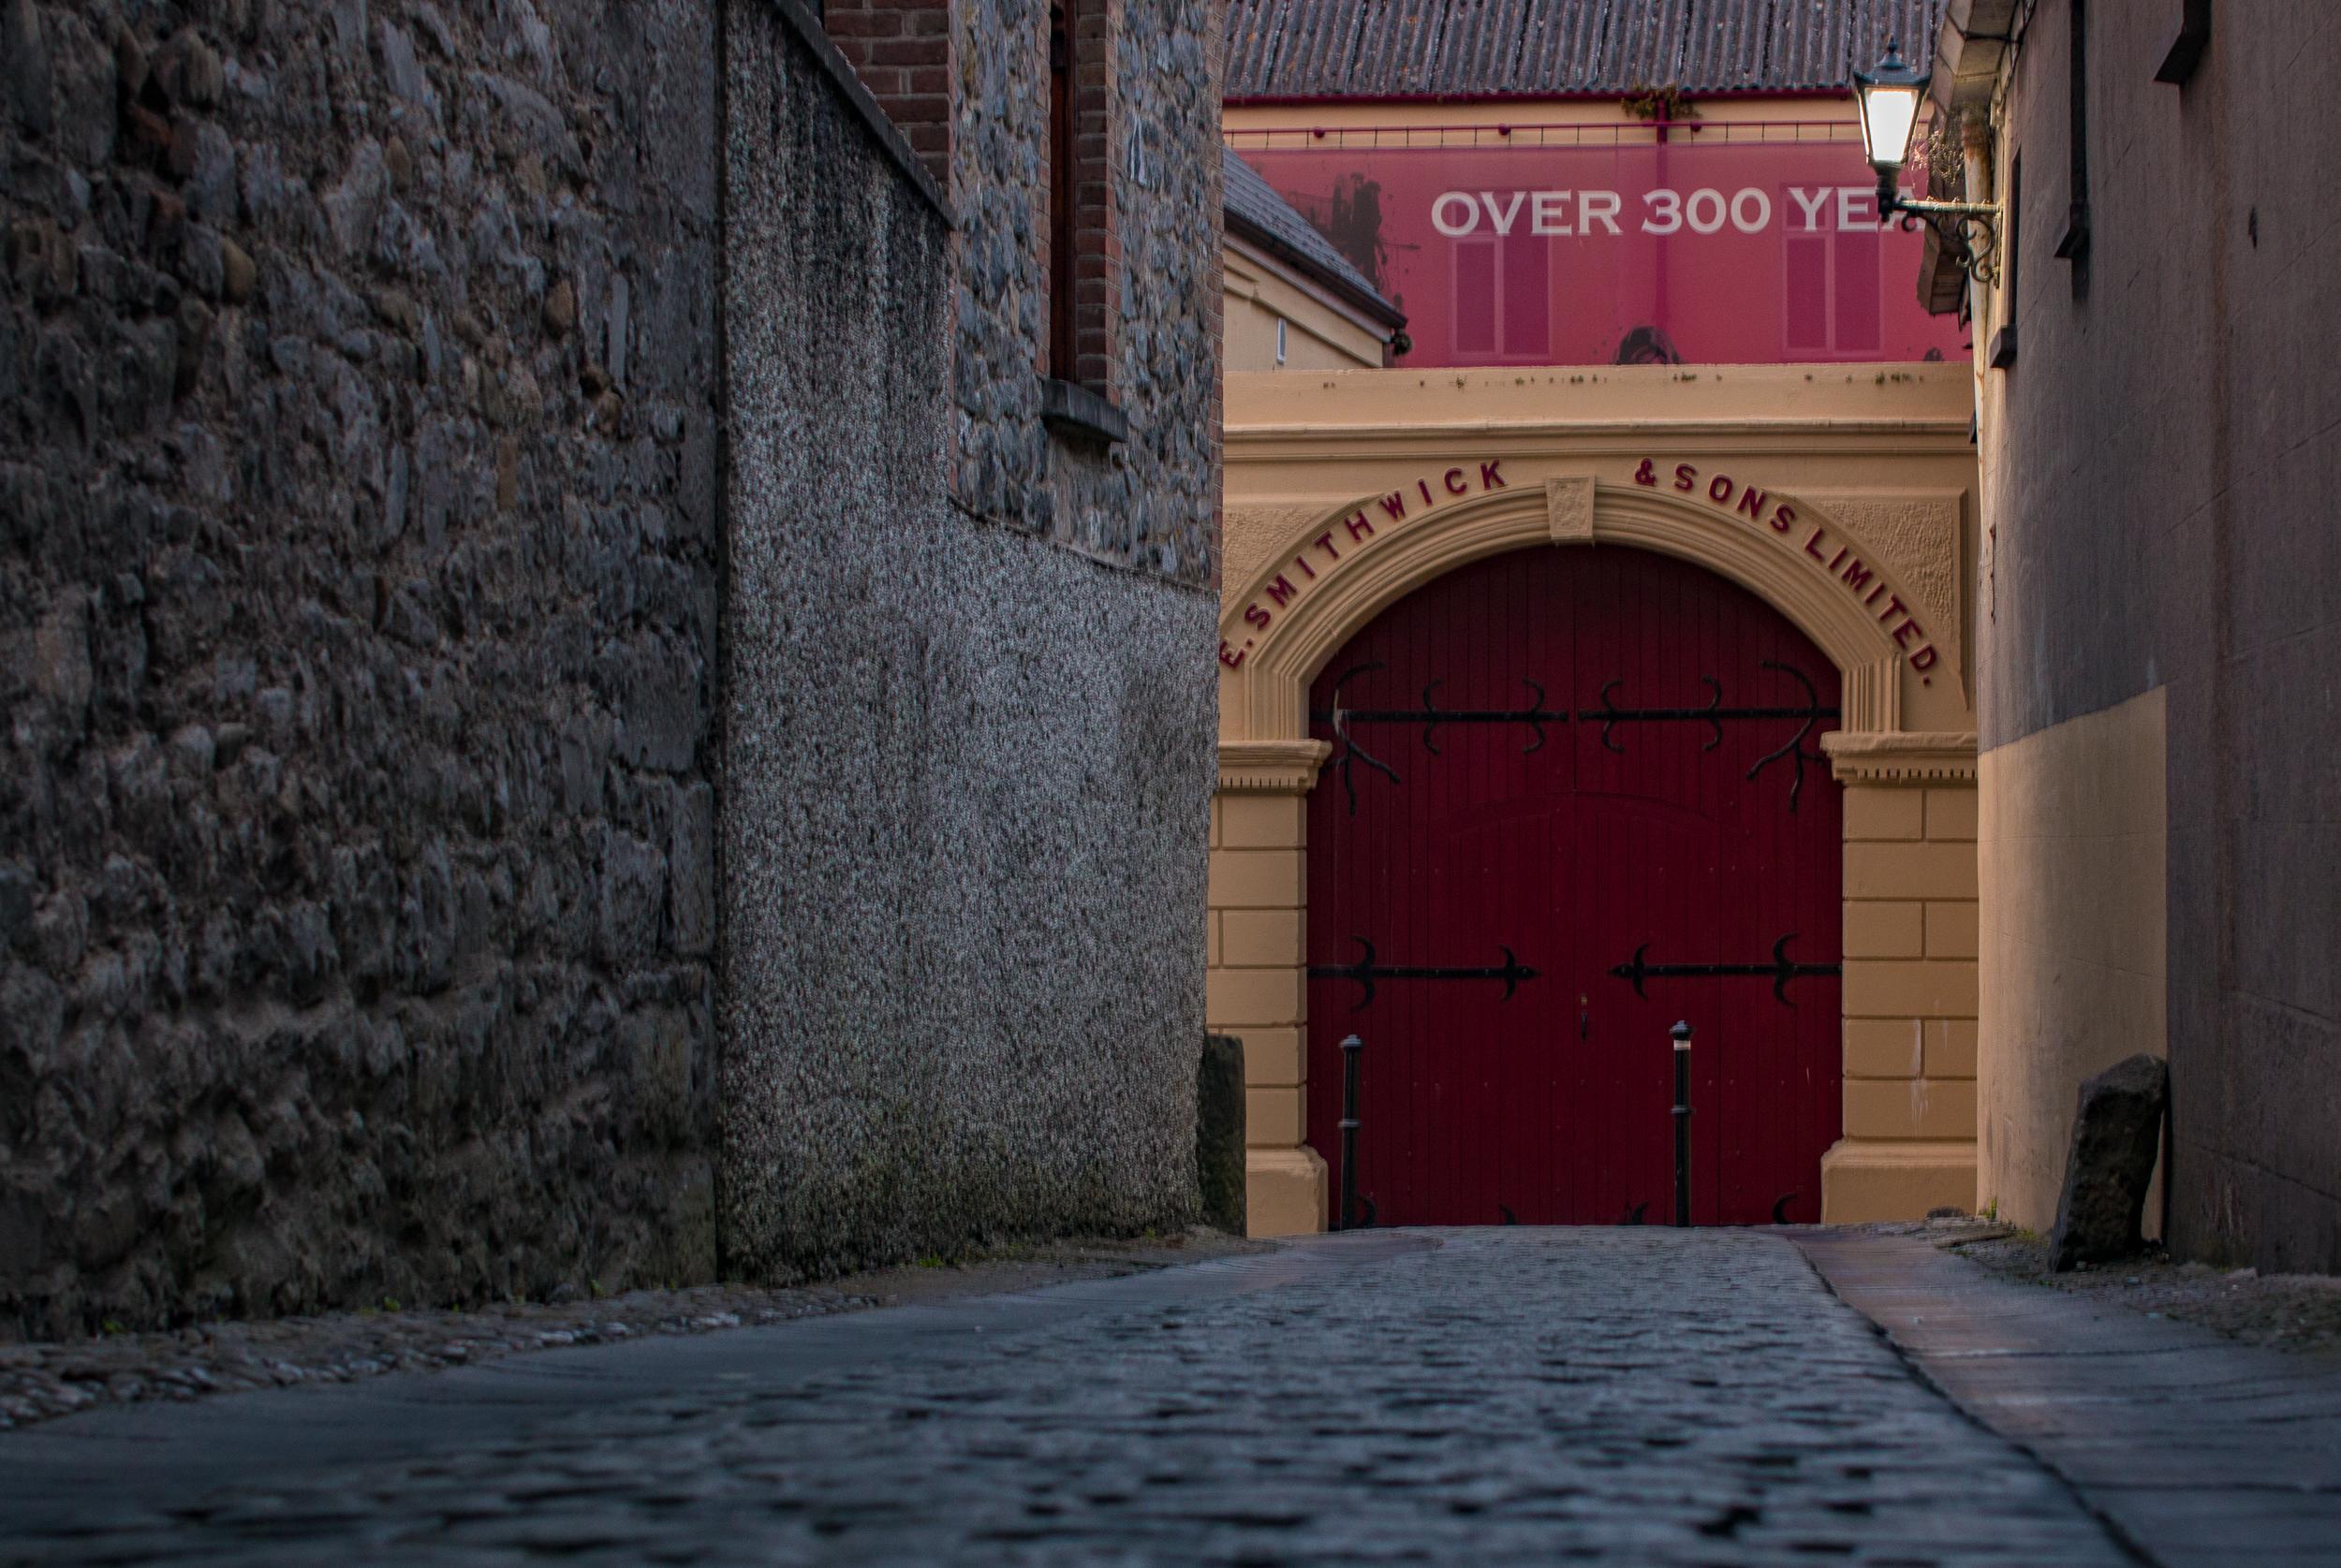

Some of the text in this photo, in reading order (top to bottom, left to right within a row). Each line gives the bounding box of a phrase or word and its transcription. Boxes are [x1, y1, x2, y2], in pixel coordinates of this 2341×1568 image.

[1430, 188, 1624, 238] OVER
[1641, 188, 1772, 234] 300
[1244, 459, 1508, 631] SMITHWICK
[1635, 457, 1656, 487] &
[1673, 462, 1796, 535] SONS
